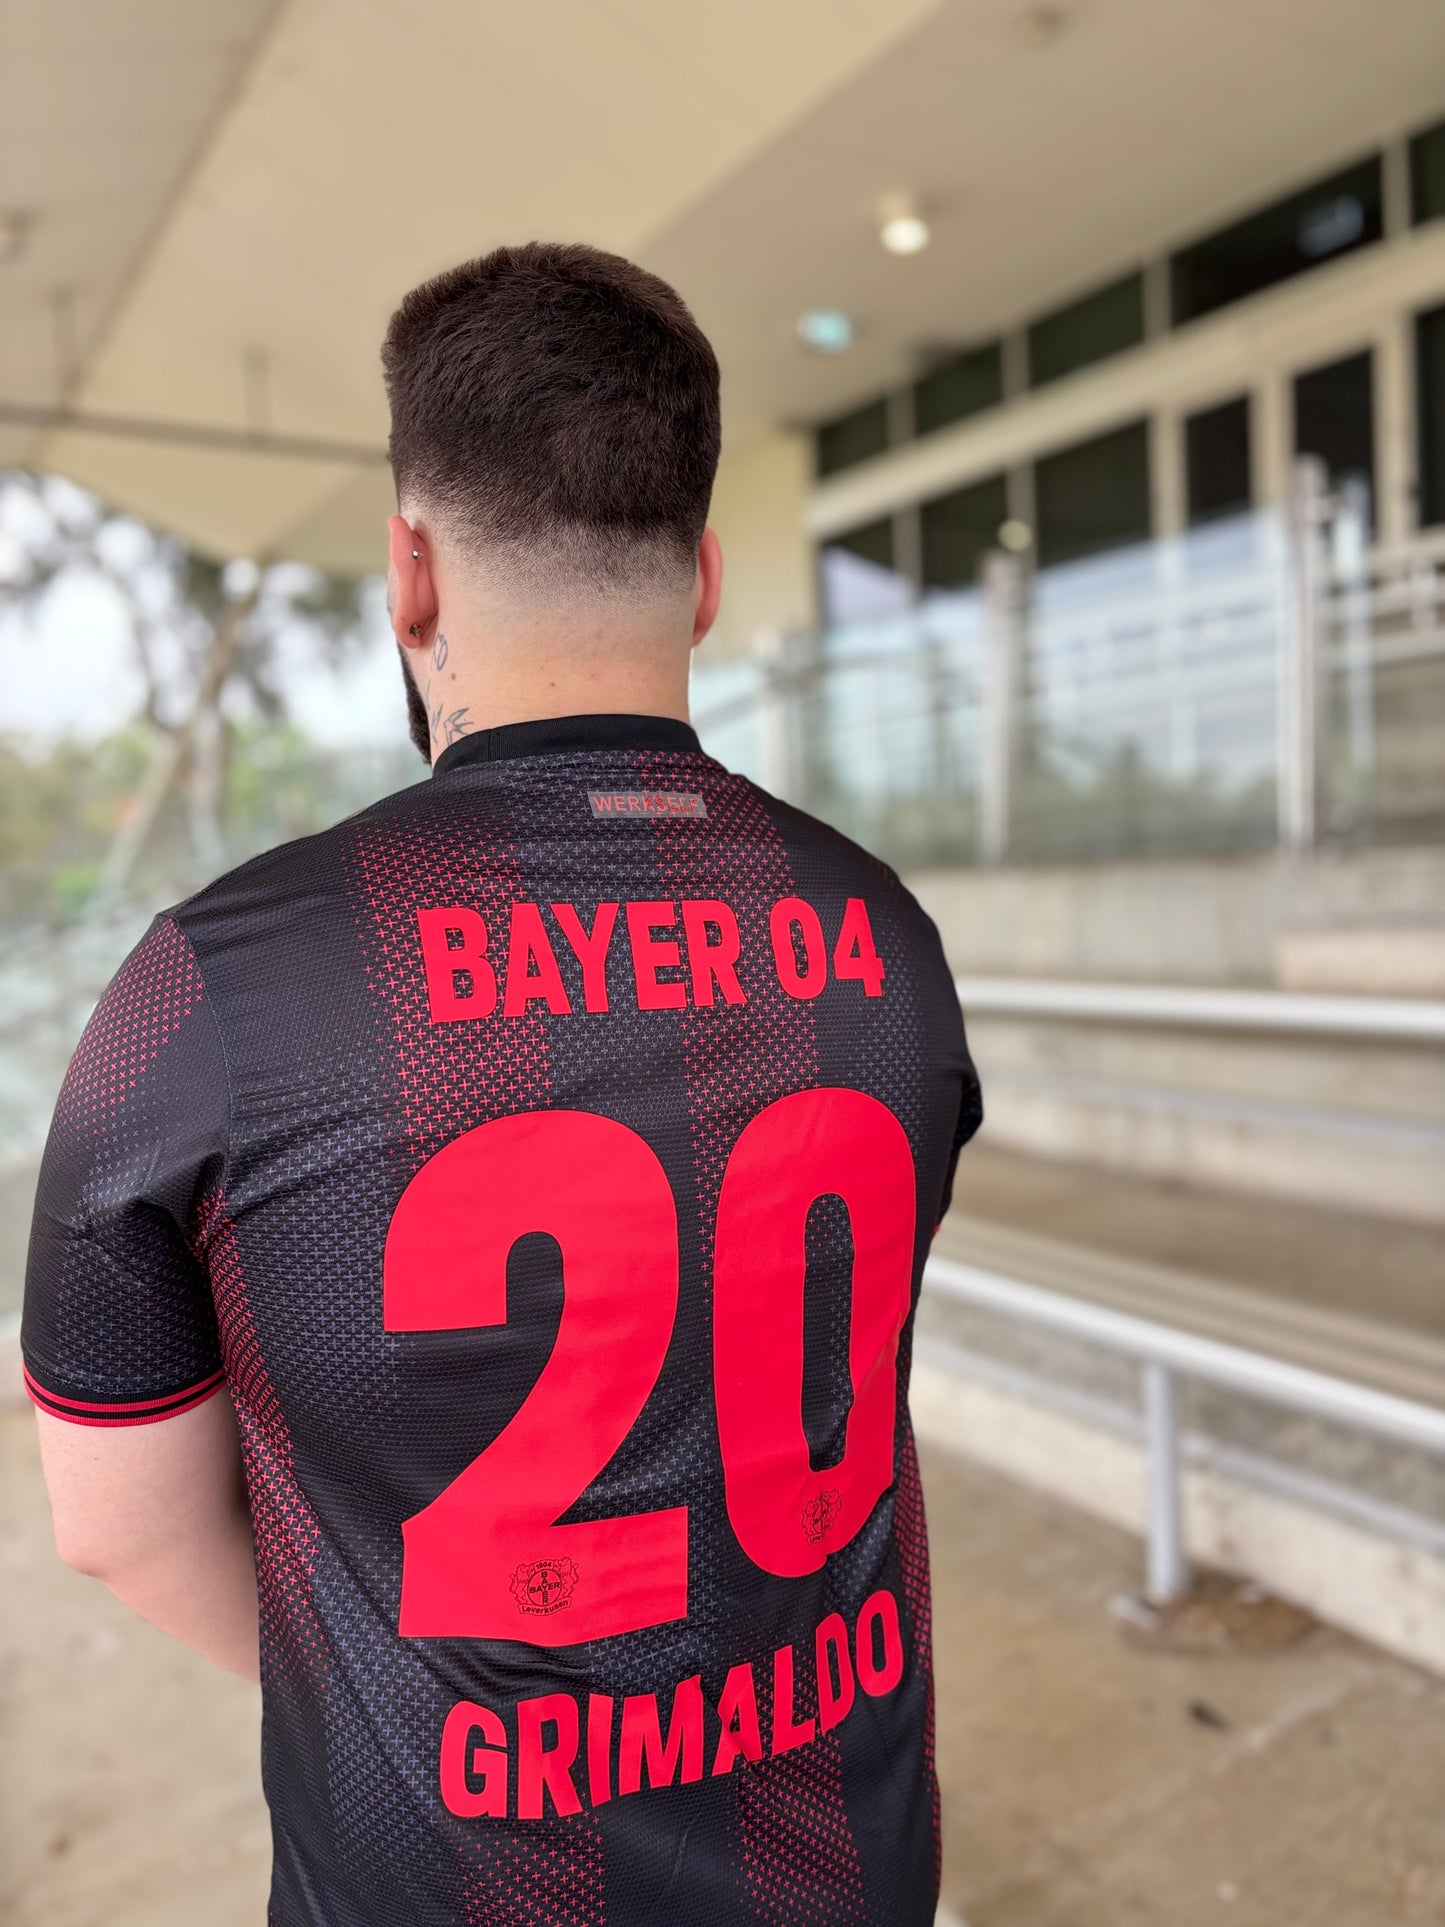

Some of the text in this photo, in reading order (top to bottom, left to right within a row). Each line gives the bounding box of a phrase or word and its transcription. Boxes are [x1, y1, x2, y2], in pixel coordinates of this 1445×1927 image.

[593, 795, 699, 813] WERKSELF
[415, 896, 886, 1023] BAYER 04
[384, 1087, 915, 1645] 20
[529, 1582, 560, 1593] BAYER
[541, 1571, 549, 1604] BAYER
[521, 1600, 568, 1613] Leverkusen
[440, 1590, 904, 1819] GRIMALDO
